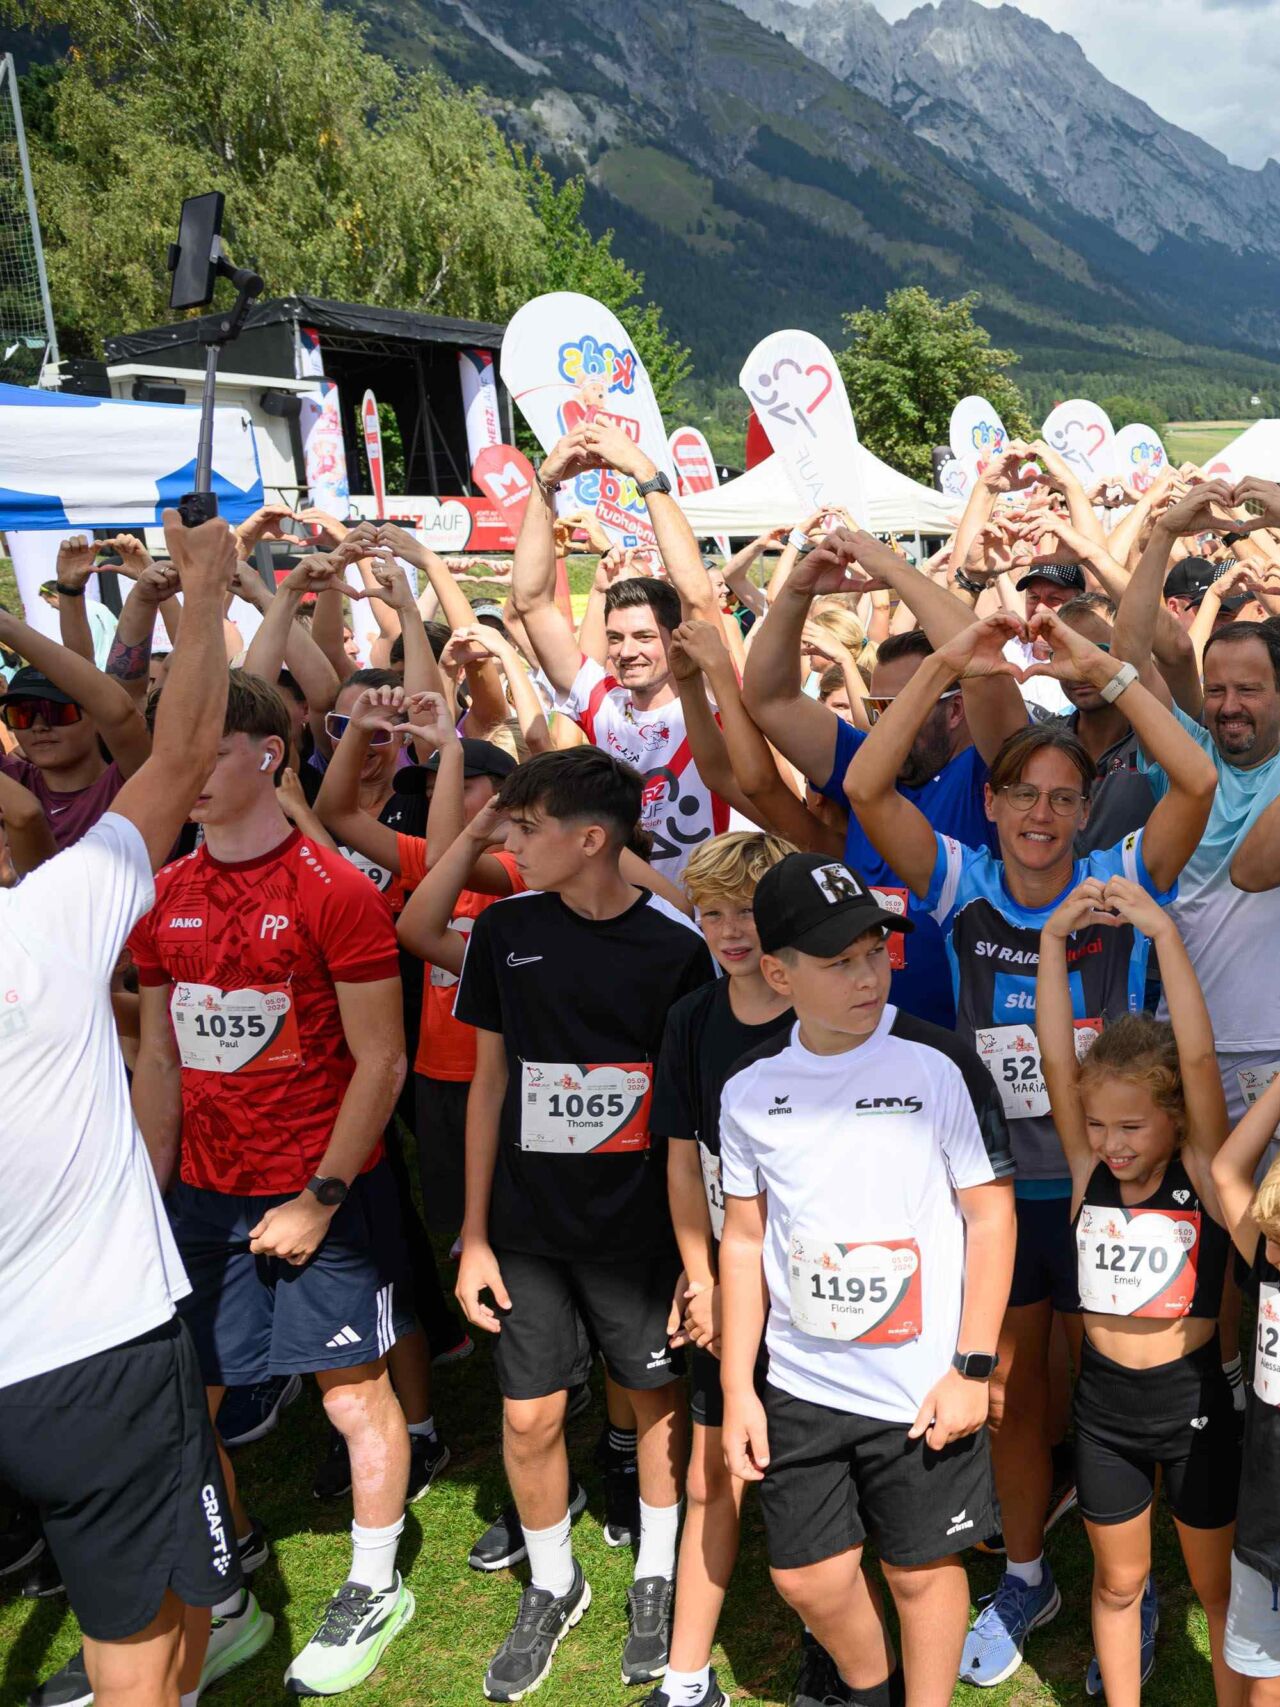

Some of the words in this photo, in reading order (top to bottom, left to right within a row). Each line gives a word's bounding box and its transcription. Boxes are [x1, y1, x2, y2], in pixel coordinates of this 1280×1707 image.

[169, 918, 203, 928] JAKO
[260, 914, 290, 940] PP
[975, 941, 998, 957] SV
[195, 1014, 266, 1038] 1035
[219, 1040, 239, 1049] Paul
[548, 1094, 624, 1118] 1065
[768, 1106, 792, 1116] erima
[566, 1119, 604, 1128] Thomas
[1095, 1243, 1168, 1274] 1270
[810, 1273, 888, 1303] 1195
[1114, 1275, 1143, 1288] Emely
[831, 1303, 865, 1315] Florian
[202, 1483, 228, 1554] CRAFT
[946, 1519, 974, 1536] erima
